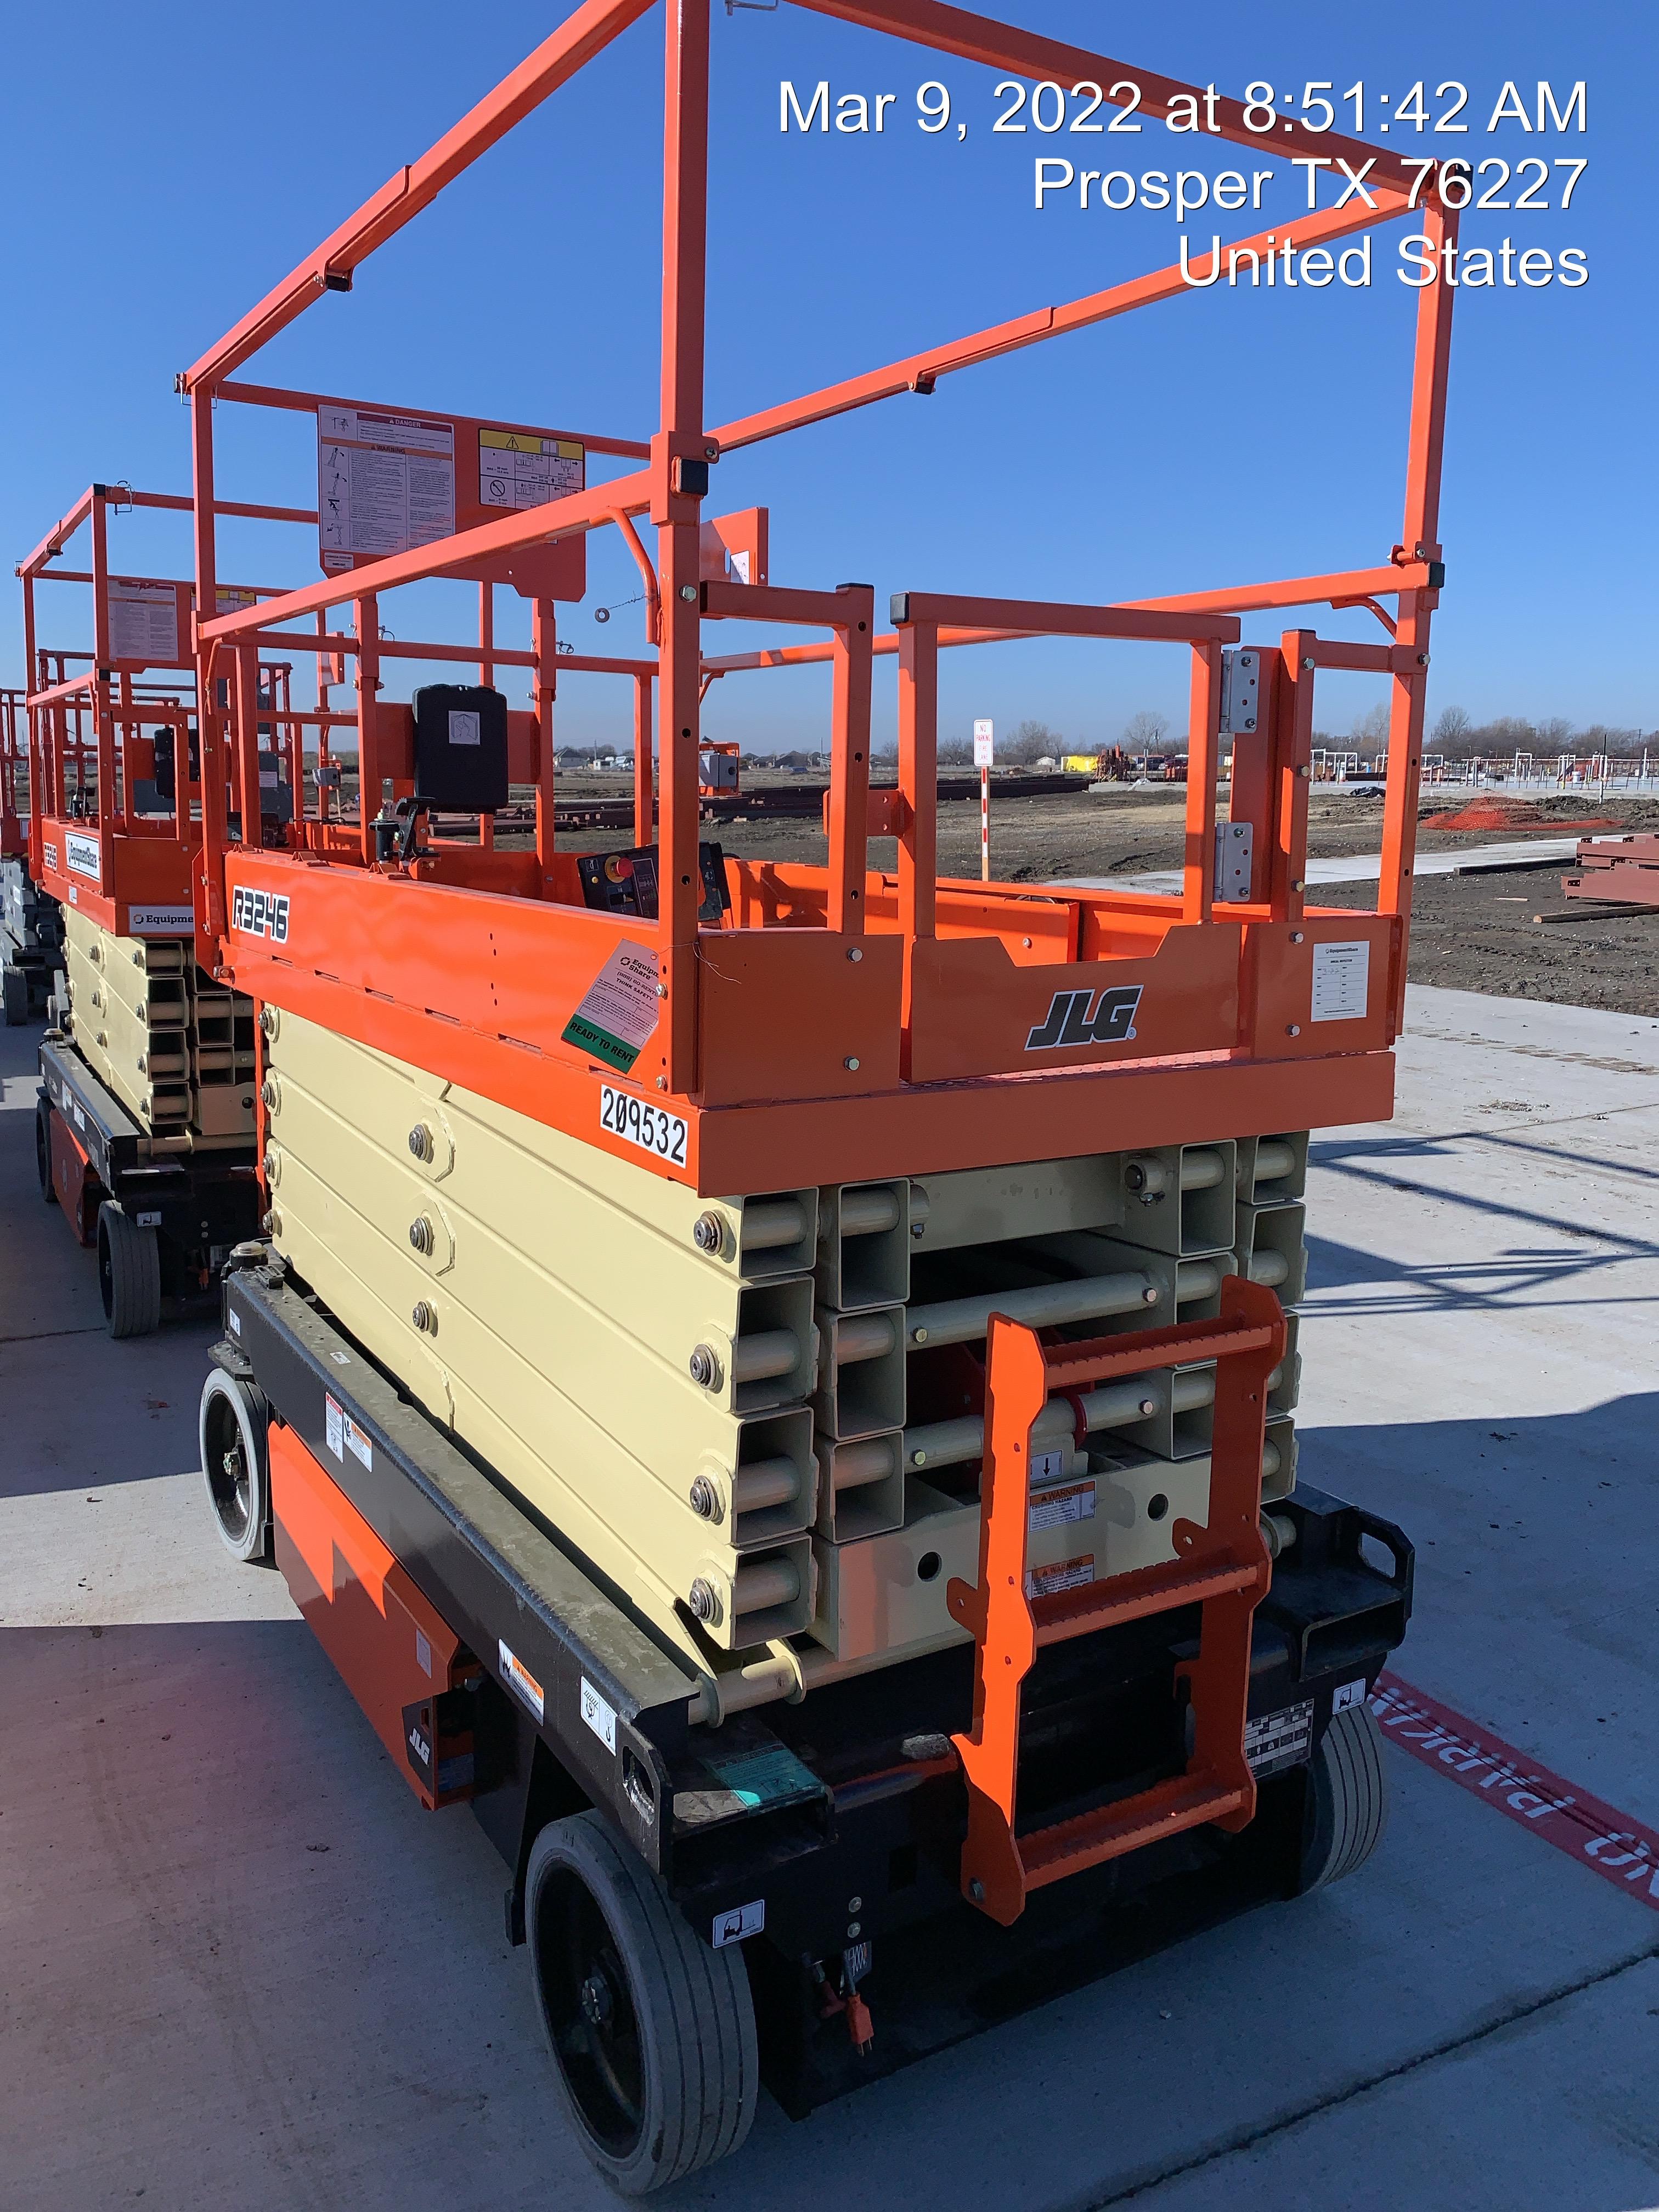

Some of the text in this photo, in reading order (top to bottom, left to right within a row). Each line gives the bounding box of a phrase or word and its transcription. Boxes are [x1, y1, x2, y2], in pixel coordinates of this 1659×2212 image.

[395, 420, 421, 428] DANGER
[377, 444, 405, 454] WARNING
[146, 915, 194, 924] Equipme
[232, 885, 290, 943] R3246
[628, 964, 651, 980] Share
[631, 958, 659, 979] Equipm
[616, 978, 633, 989] THINK
[633, 987, 653, 1001] SAFETY
[1024, 985, 1144, 1051] JLG
[569, 1022, 635, 1063] READY TO RENT
[602, 1088, 685, 1164] 209532
[1048, 1485, 1084, 1500] WARNING
[409, 1728, 430, 1765] JLG
[1367, 1677, 1576, 1819] PARKIN
